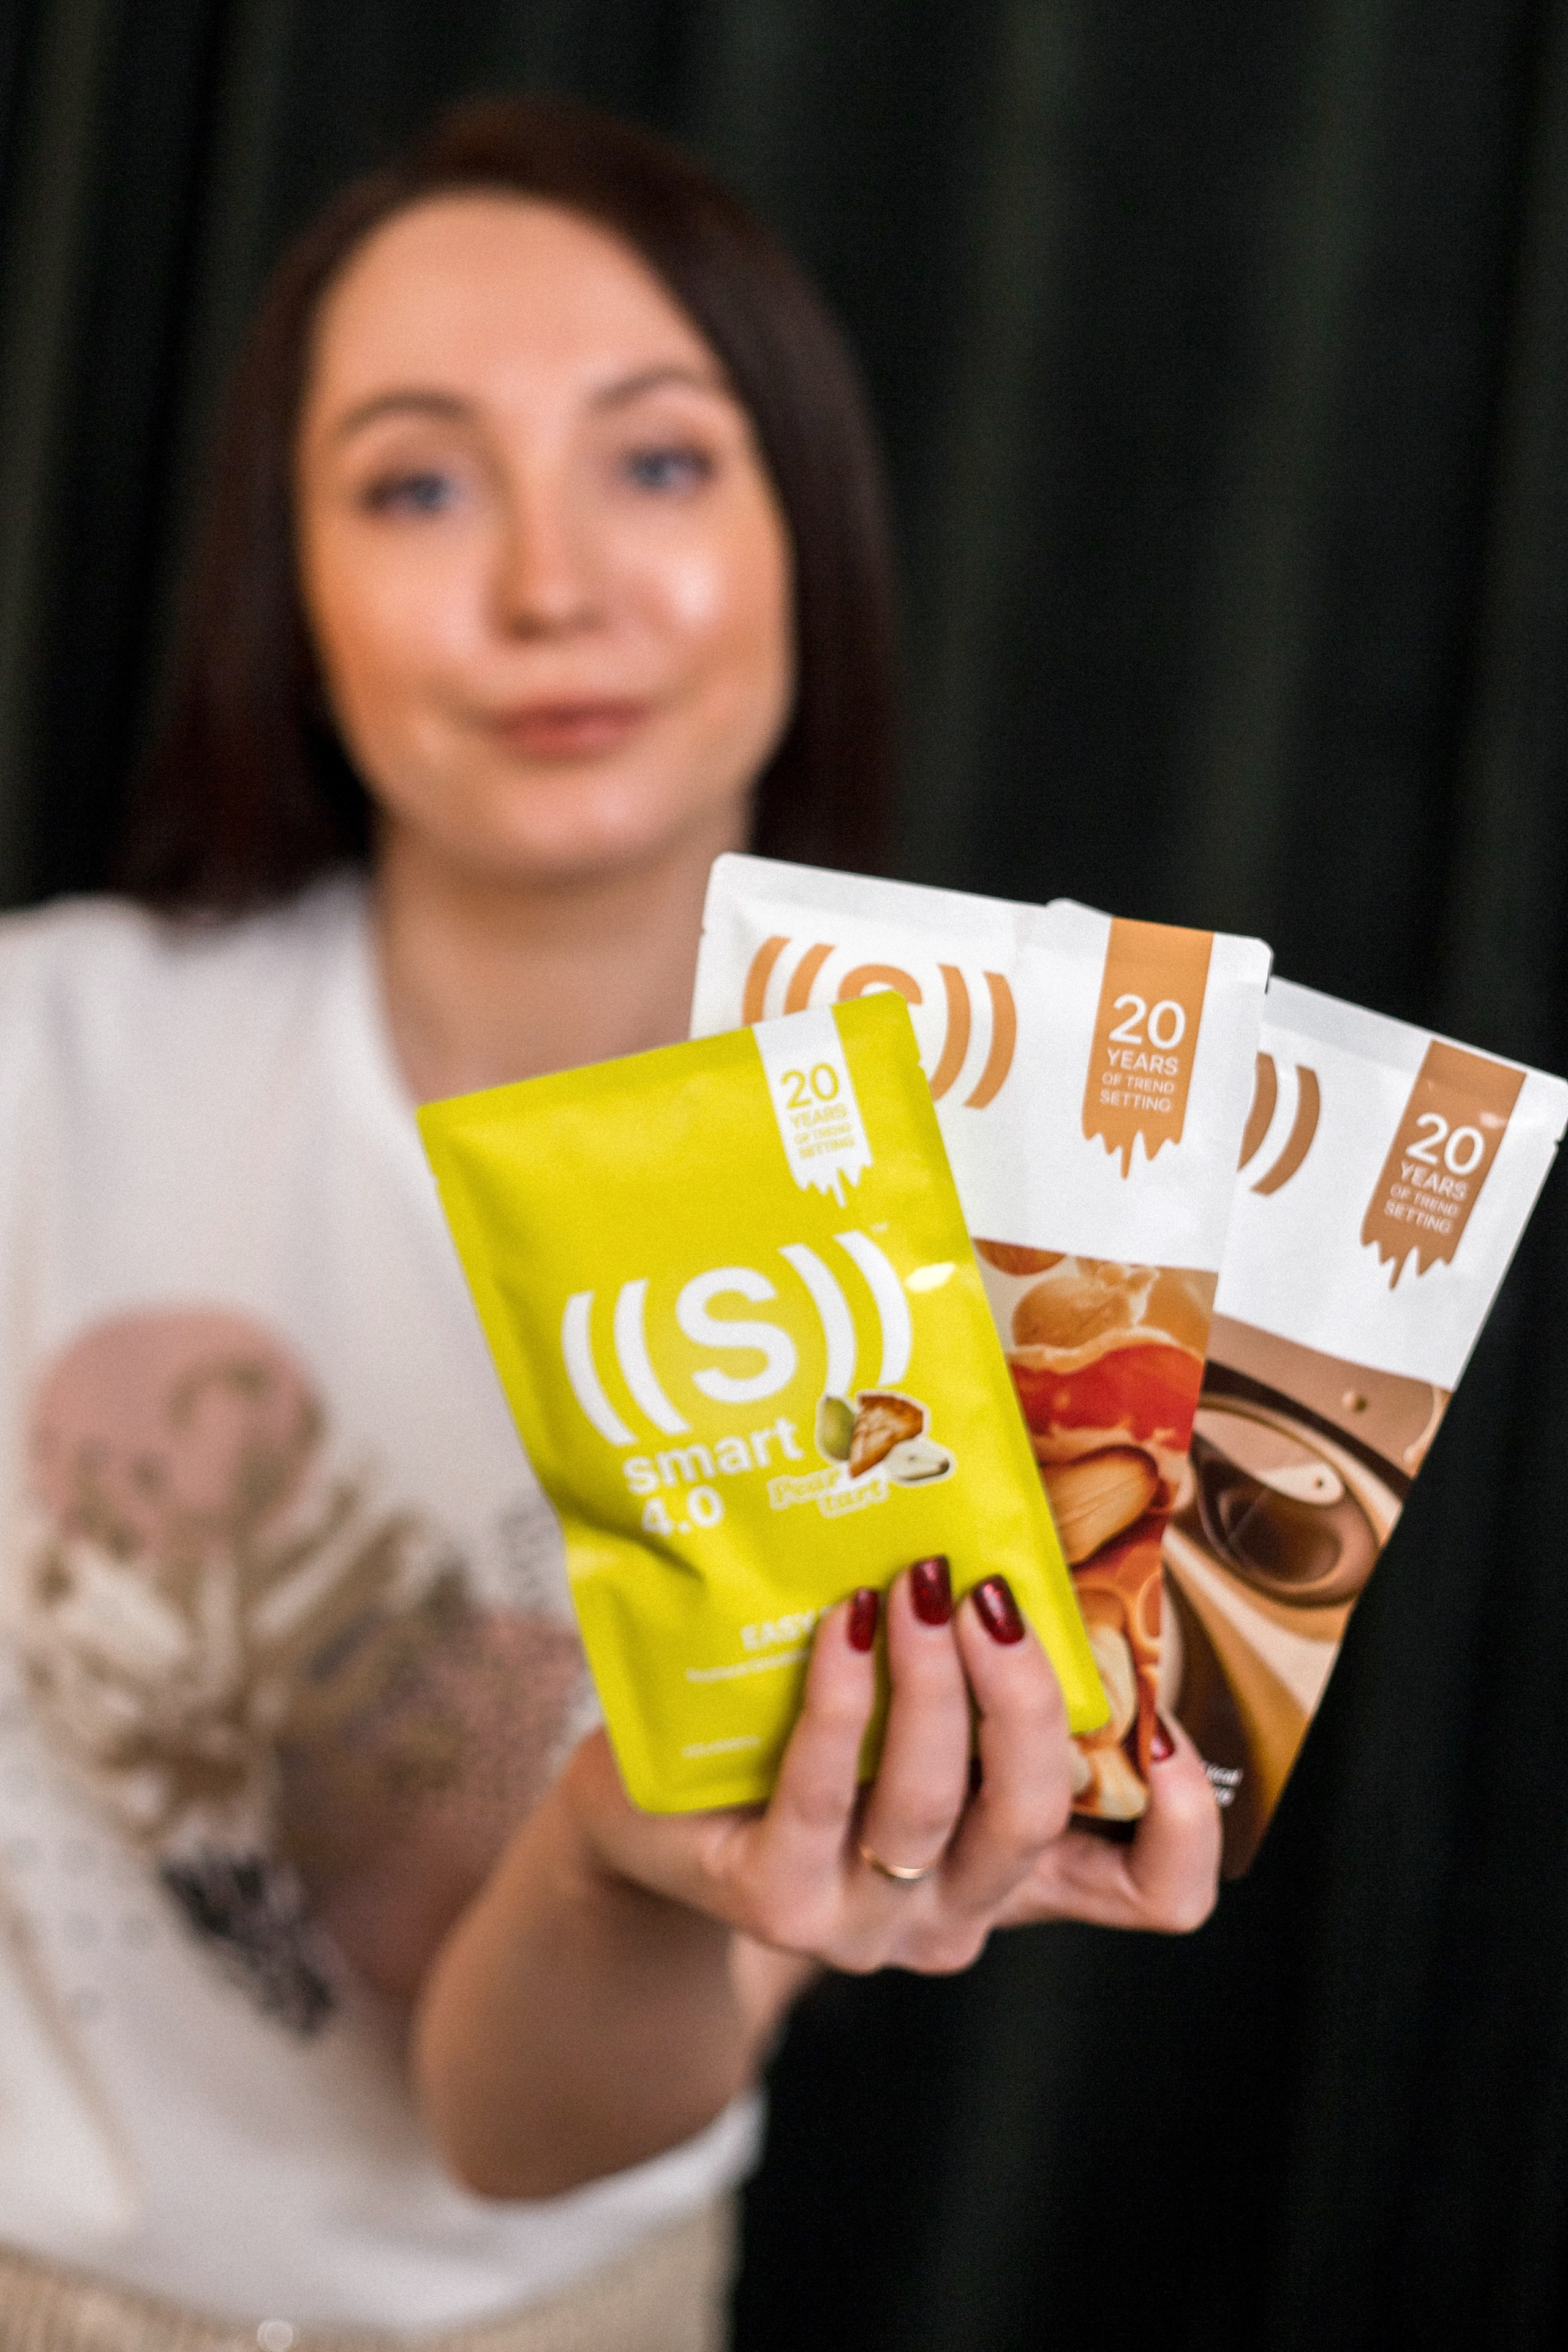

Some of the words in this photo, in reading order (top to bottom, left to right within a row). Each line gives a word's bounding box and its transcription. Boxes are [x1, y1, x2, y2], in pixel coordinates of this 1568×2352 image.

[1109, 993, 1186, 1050] 20
[1102, 1071, 1122, 1085] OF
[1128, 1074, 1175, 1095] TREND
[1107, 1047, 1179, 1076] YEARS
[780, 1063, 839, 1109] 20
[1100, 1088, 1172, 1113] SETTING
[790, 1103, 847, 1128] YEARS
[1405, 1112, 1485, 1175] 20
[1401, 1158, 1469, 1202] YEARS
[622, 1417, 804, 1494] smart
[641, 1484, 725, 1537] 4.0
[741, 1608, 817, 1651] EASY
